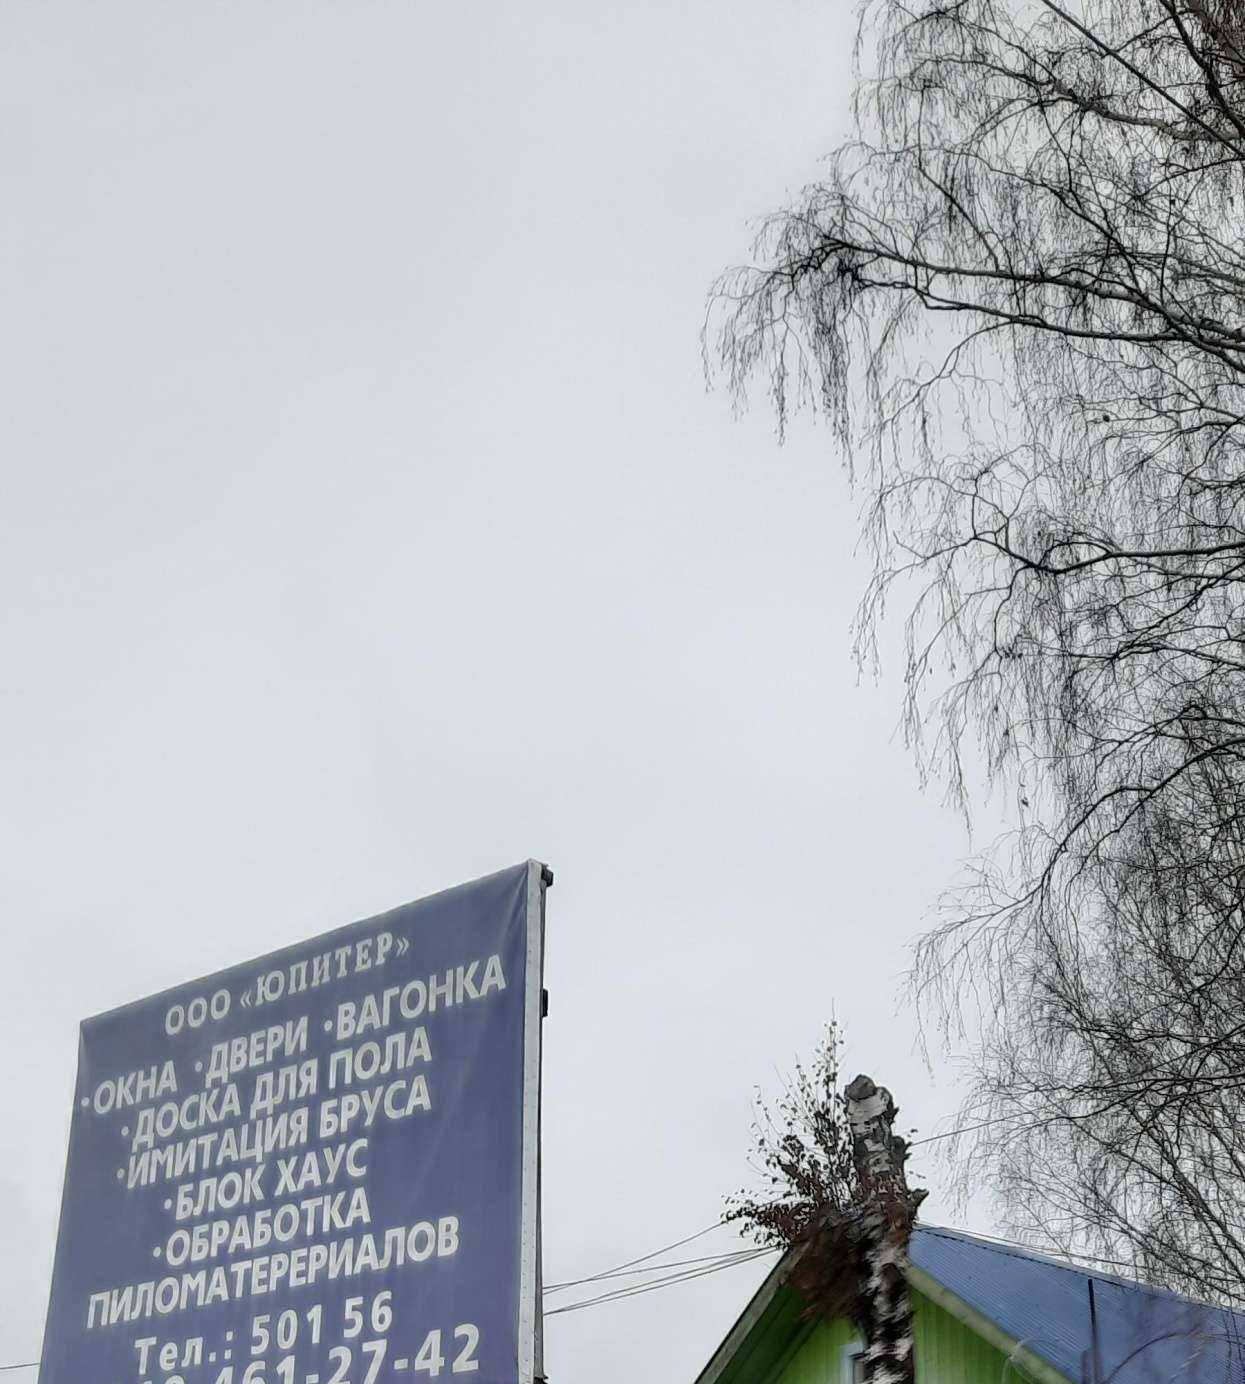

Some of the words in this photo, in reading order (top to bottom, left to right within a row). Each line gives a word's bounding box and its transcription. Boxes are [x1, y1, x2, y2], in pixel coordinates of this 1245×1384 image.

[94, 1060, 178, 1114] ОКНА
[205, 1016, 309, 1088] ДВЕРИ
[336, 953, 507, 1040] ВАГОНКА
[165, 989, 231, 1036] ООО
[240, 931, 410, 1008] «ЮПИТЕР»
[127, 1107, 309, 1189] ИМИТАЦИЯ
[319, 1074, 432, 1138] БРУСА
[132, 1083, 241, 1153] ДОСКА
[250, 1058, 318, 1119] ДЛЯ
[328, 1026, 432, 1089] ПОЛА
[165, 1186, 371, 1266] ОБРАБОТКА
[176, 1163, 266, 1221] БЛОК
[274, 1138, 368, 1197] ХАУС
[86, 1216, 460, 1329] ПИЛОМАТЕРЕРИАЛОВ
[134, 1330, 235, 1376] Тел.:
[250, 1304, 323, 1356] 501
[343, 1290, 393, 1339] 56
